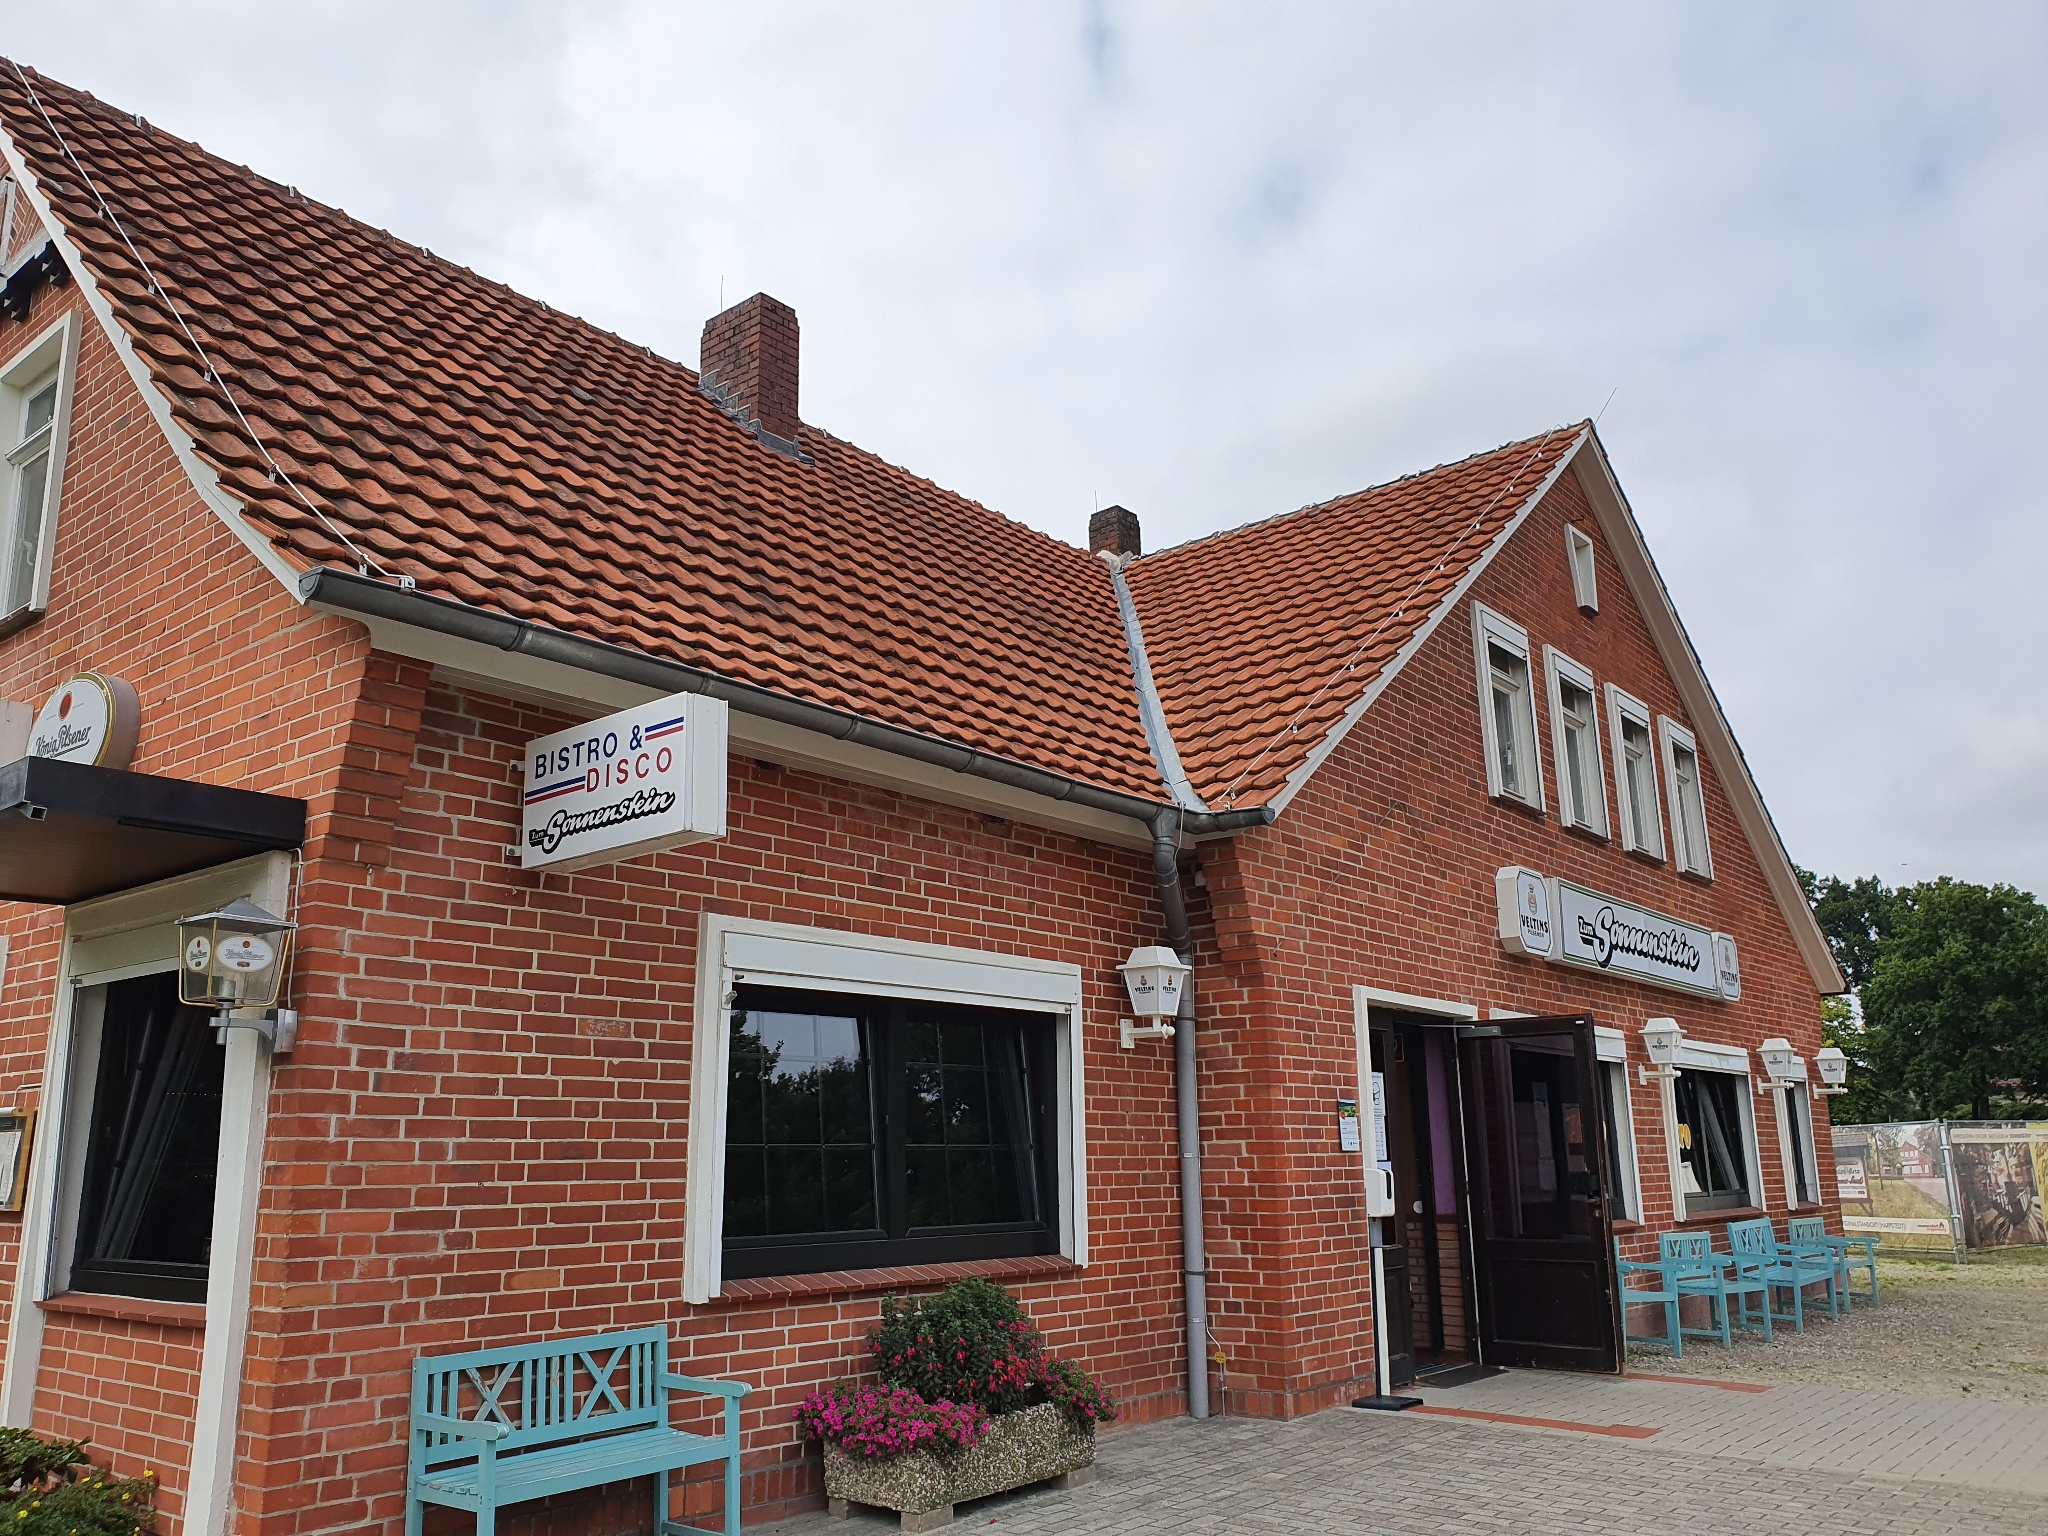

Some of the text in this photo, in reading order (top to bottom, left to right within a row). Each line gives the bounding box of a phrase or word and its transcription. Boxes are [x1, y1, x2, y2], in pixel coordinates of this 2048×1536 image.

[56, 724, 92, 750] Pilsener
[534, 724, 643, 779] BISTRO &
[586, 746, 673, 793] DISCO
[541, 787, 676, 854] Sonnenstein
[1520, 914, 1549, 933] VELTINS
[1578, 915, 1594, 936] Zum
